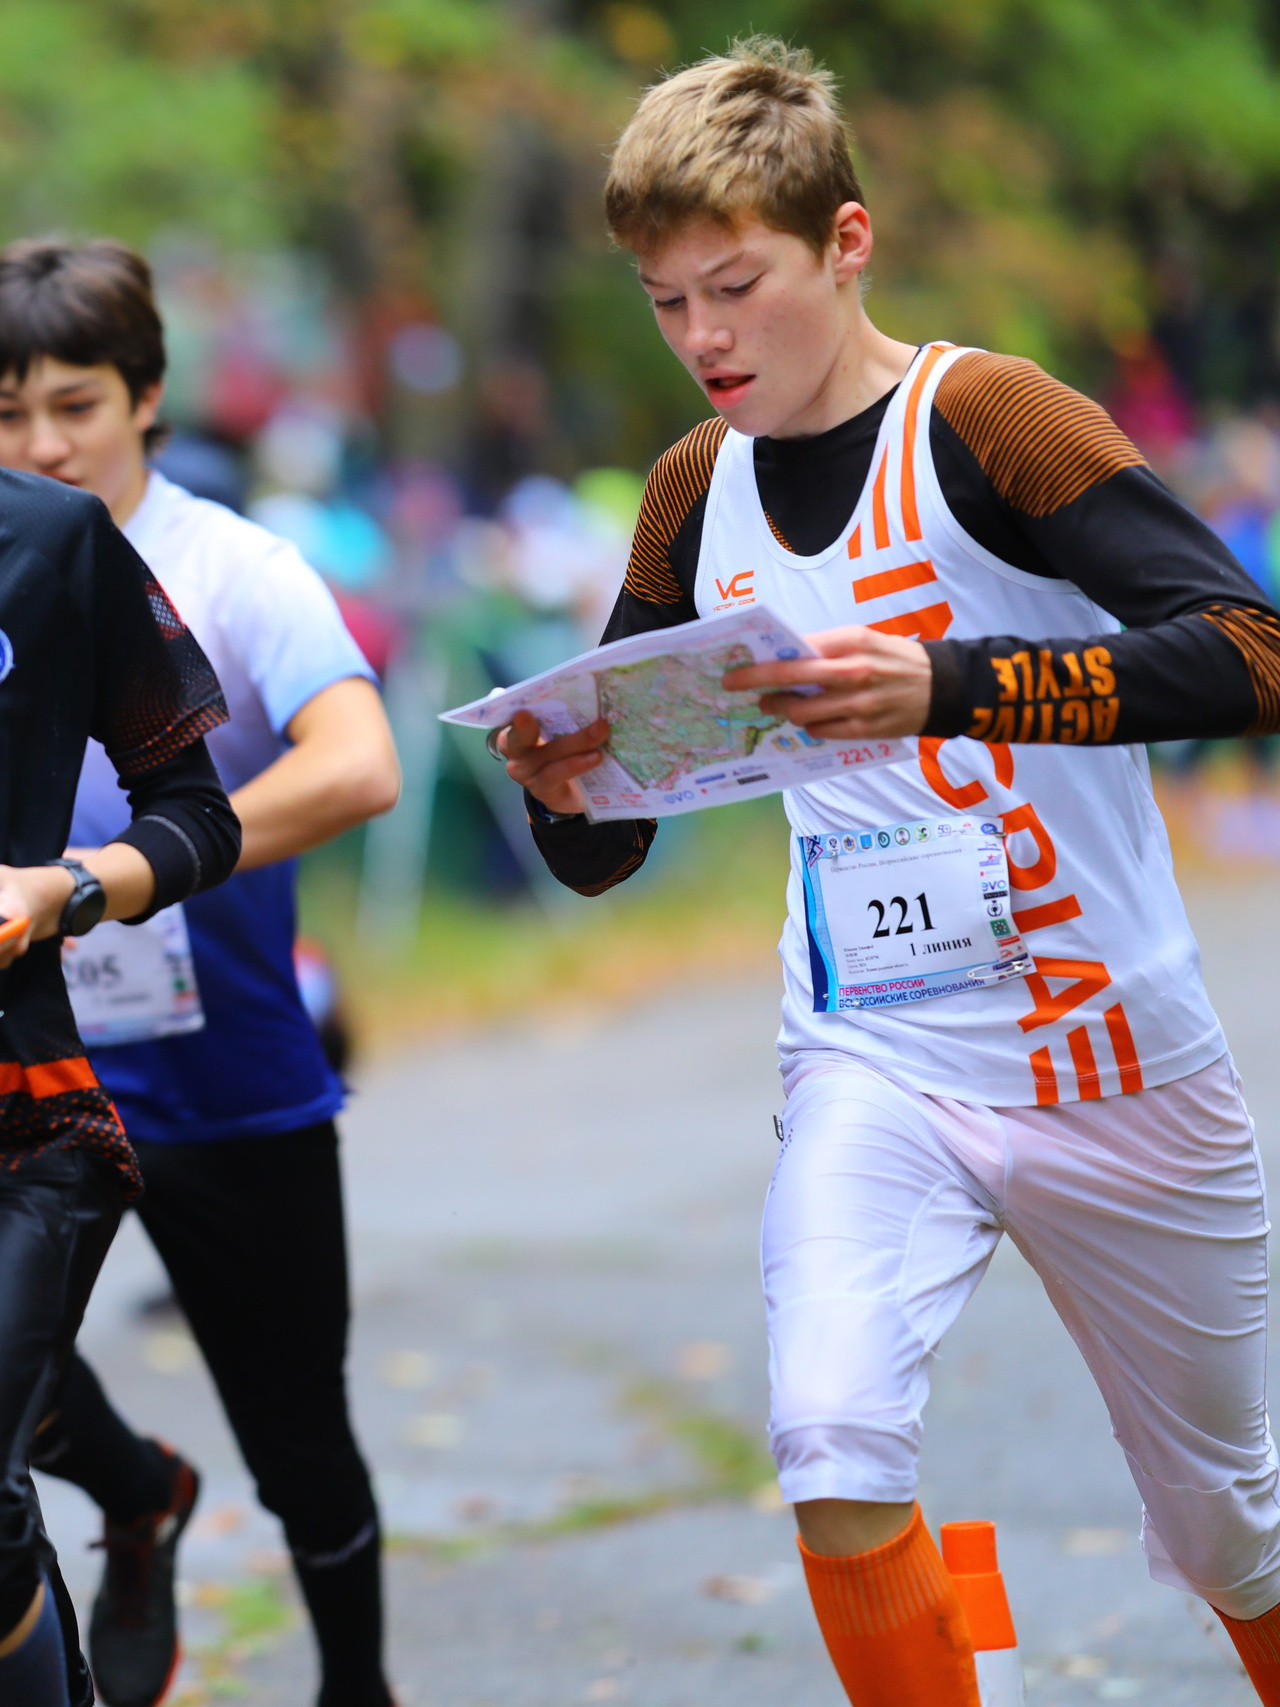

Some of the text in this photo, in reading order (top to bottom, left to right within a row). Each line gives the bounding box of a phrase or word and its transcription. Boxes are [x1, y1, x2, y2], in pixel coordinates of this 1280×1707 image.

[990, 646, 1117, 702] STYLE
[982, 880, 1006, 892] evo
[867, 892, 937, 939] 221
[909, 938, 972, 956] 1 линия
[839, 979, 925, 996] ПЕРВЕНСТВО РОССИИ
[839, 979, 986, 1008] ВСОССИЙСКИЕ СОРЕВНОВАНИЯ
